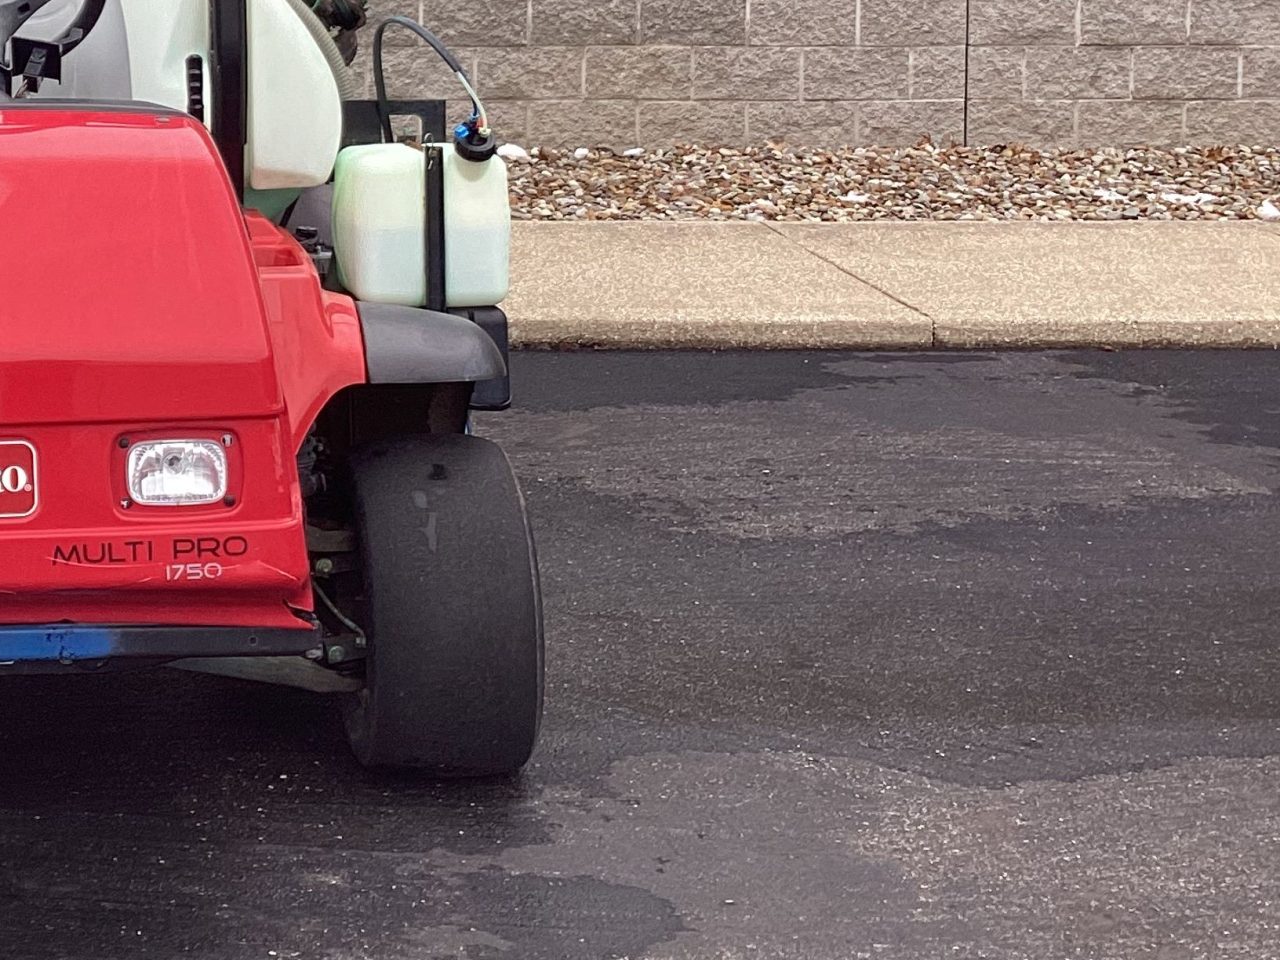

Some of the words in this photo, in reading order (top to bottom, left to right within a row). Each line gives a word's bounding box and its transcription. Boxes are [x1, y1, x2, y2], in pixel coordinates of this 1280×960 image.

[51, 540, 153, 566] MULTI
[173, 536, 248, 560] PRO
[166, 562, 222, 581] 1750
